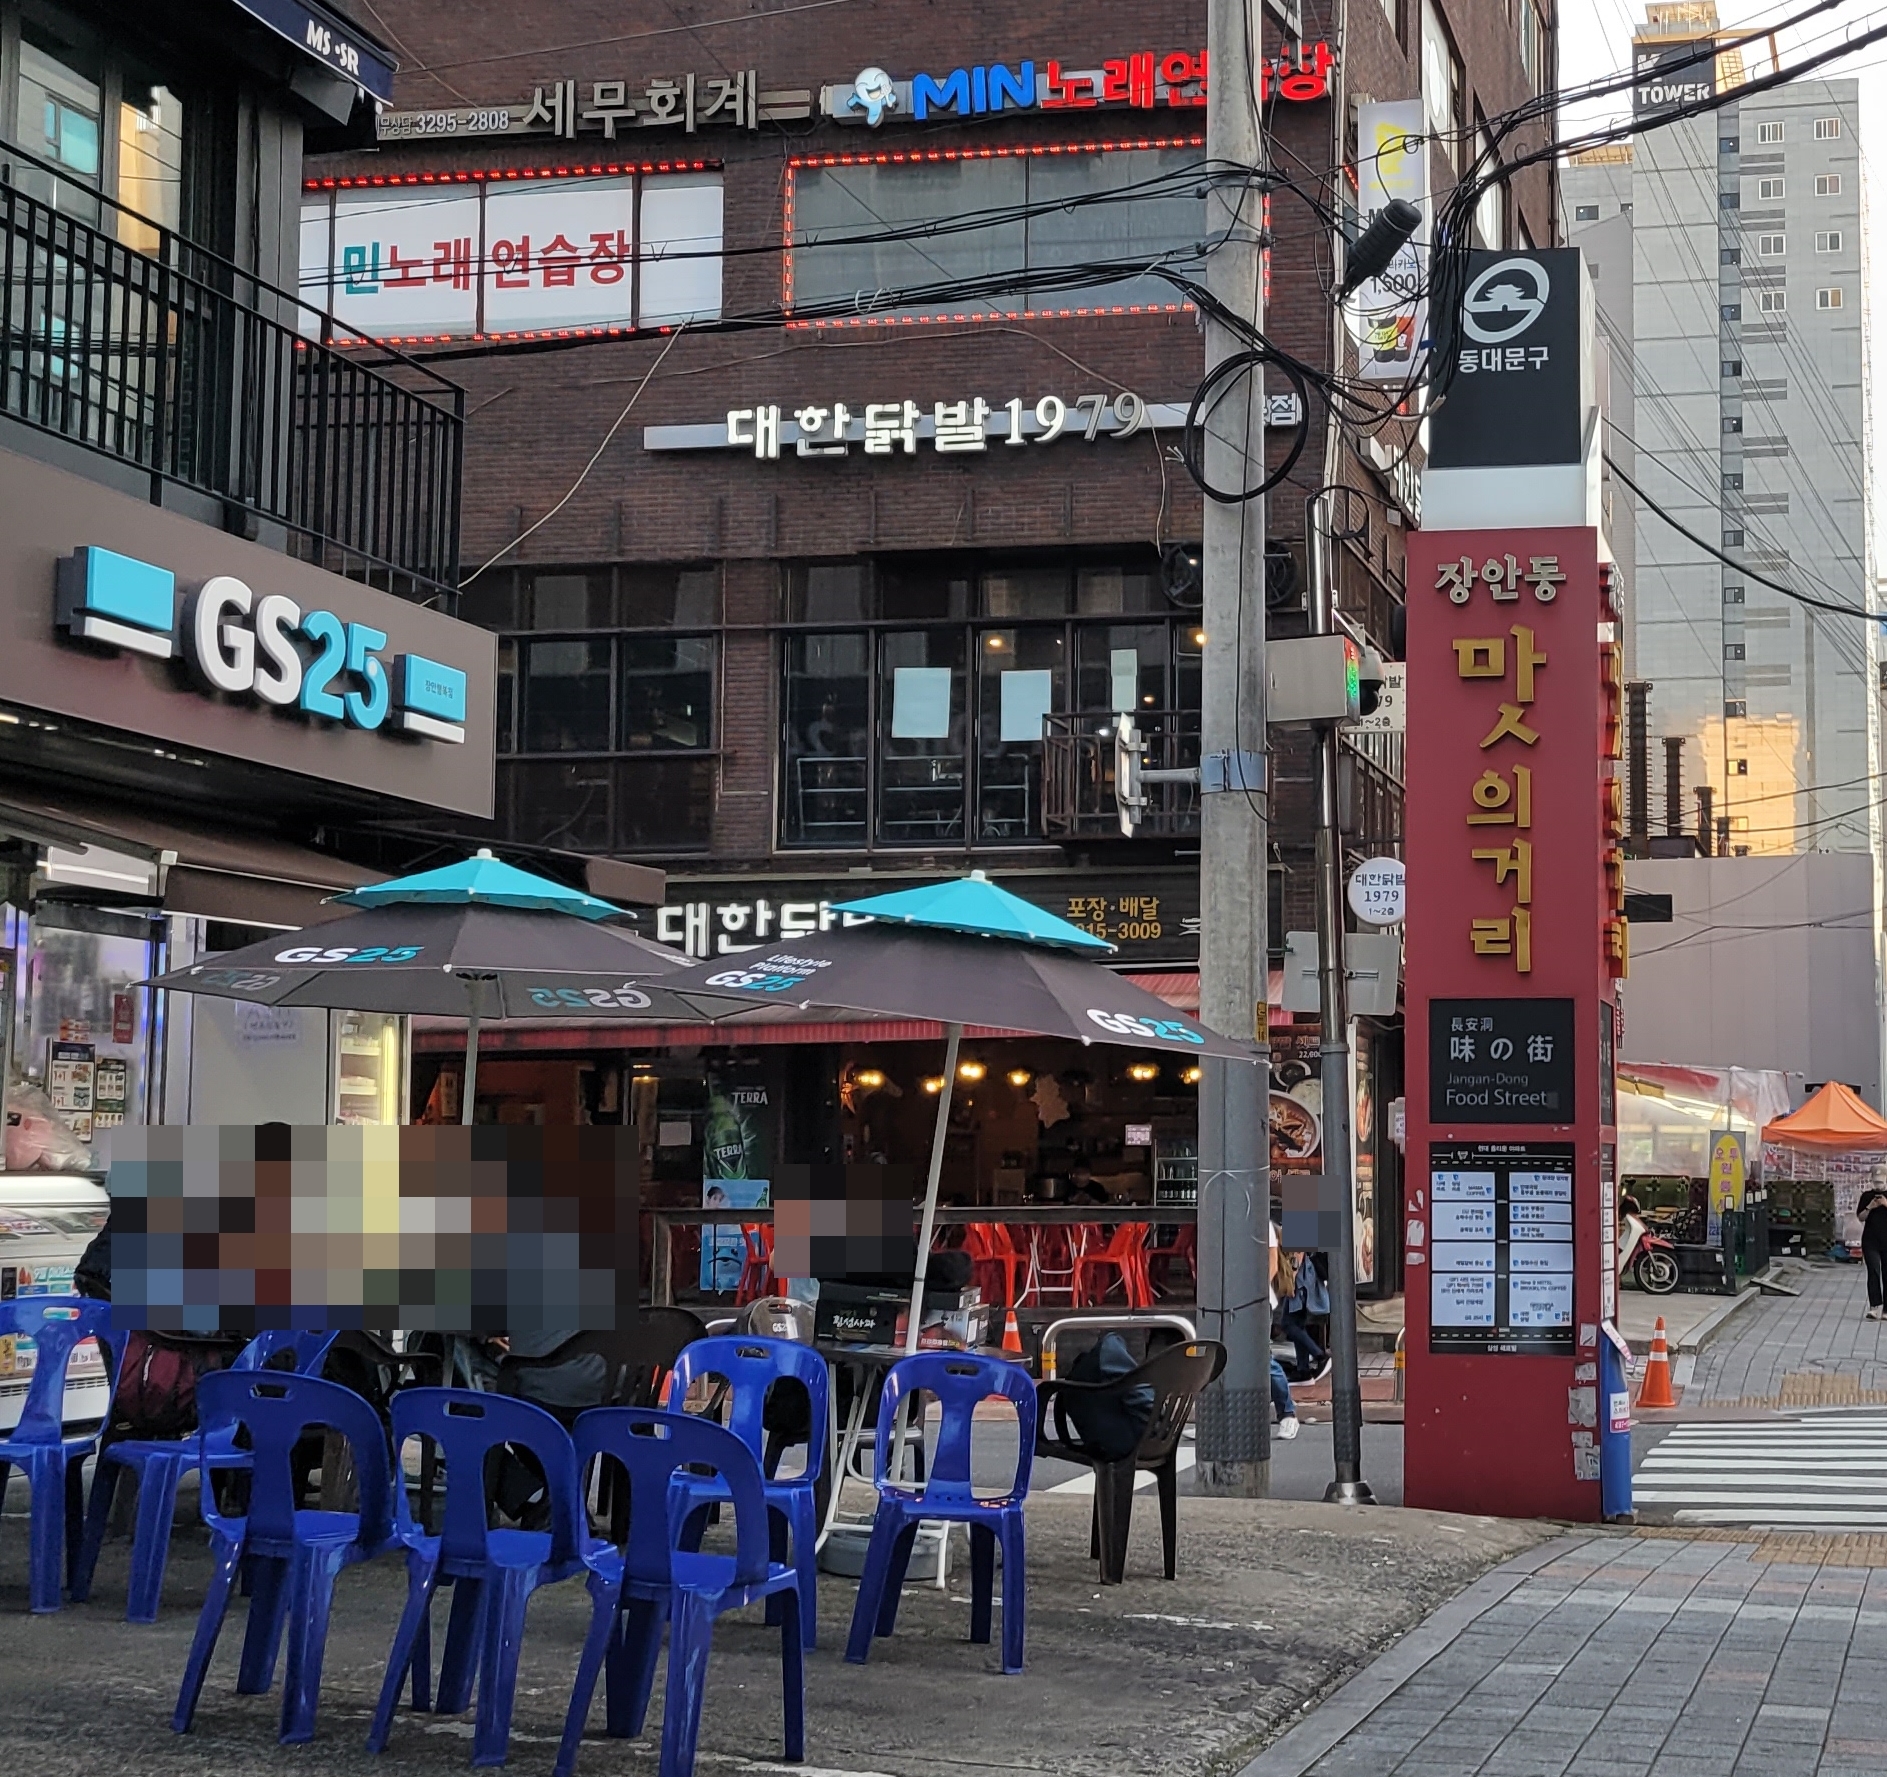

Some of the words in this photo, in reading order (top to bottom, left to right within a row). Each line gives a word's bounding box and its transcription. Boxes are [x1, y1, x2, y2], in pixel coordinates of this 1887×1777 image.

[912, 59, 1035, 120] MIN
[1040, 41, 1335, 109] 노래연장
[415, 110, 509, 134] 3295-2808
[523, 70, 760, 140] 세무회계
[1637, 82, 1711, 105] TOWER
[1457, 346, 1550, 374] 동대문구
[1435, 554, 1567, 605] 장안동
[194, 576, 389, 730] GS25
[1363, 889, 1400, 903] 1979
[273, 946, 425, 964] GS25
[765, 953, 834, 969] Lifestyle
[748, 960, 818, 977] Platform
[704, 969, 808, 993] GS25
[1085, 1007, 1205, 1045] GS25
[1446, 1072, 1529, 1087] Jangan-Dong
[731, 1091, 768, 1106] TERRA
[1446, 1088, 1489, 1106] Food
[1494, 1088, 1548, 1106] Street
